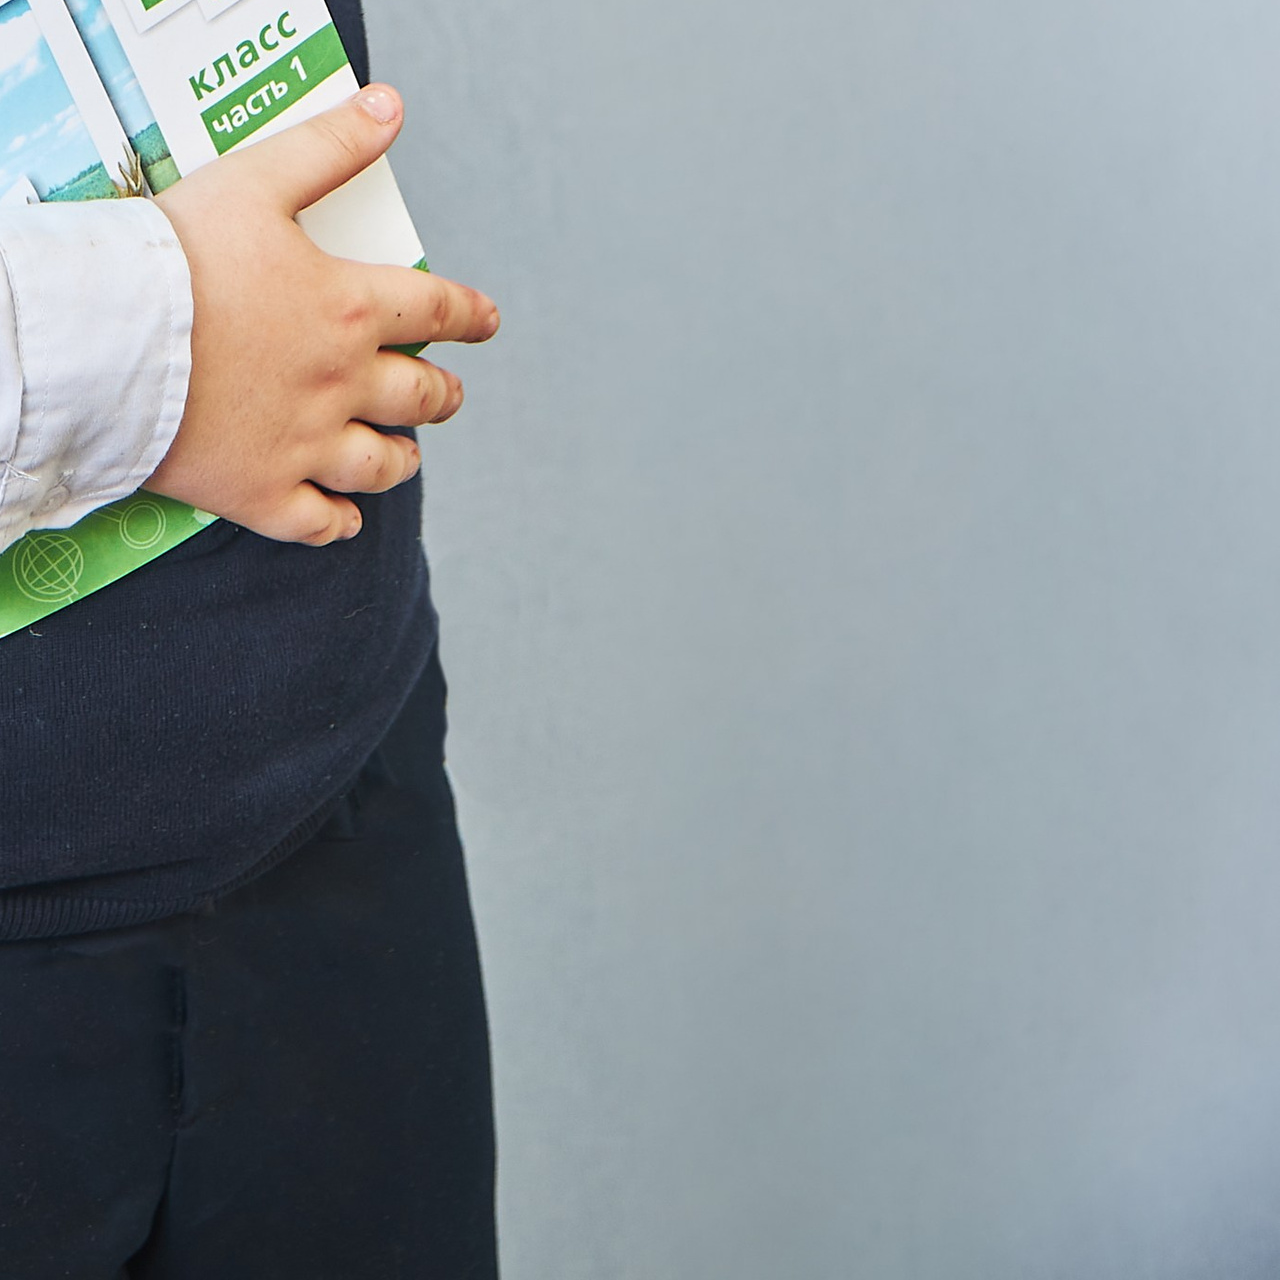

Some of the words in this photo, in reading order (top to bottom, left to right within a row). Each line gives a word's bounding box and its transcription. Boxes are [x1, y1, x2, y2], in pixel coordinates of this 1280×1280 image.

[188, 11, 297, 101] класс
[212, 79, 288, 135] часть
[289, 55, 308, 82] 1
